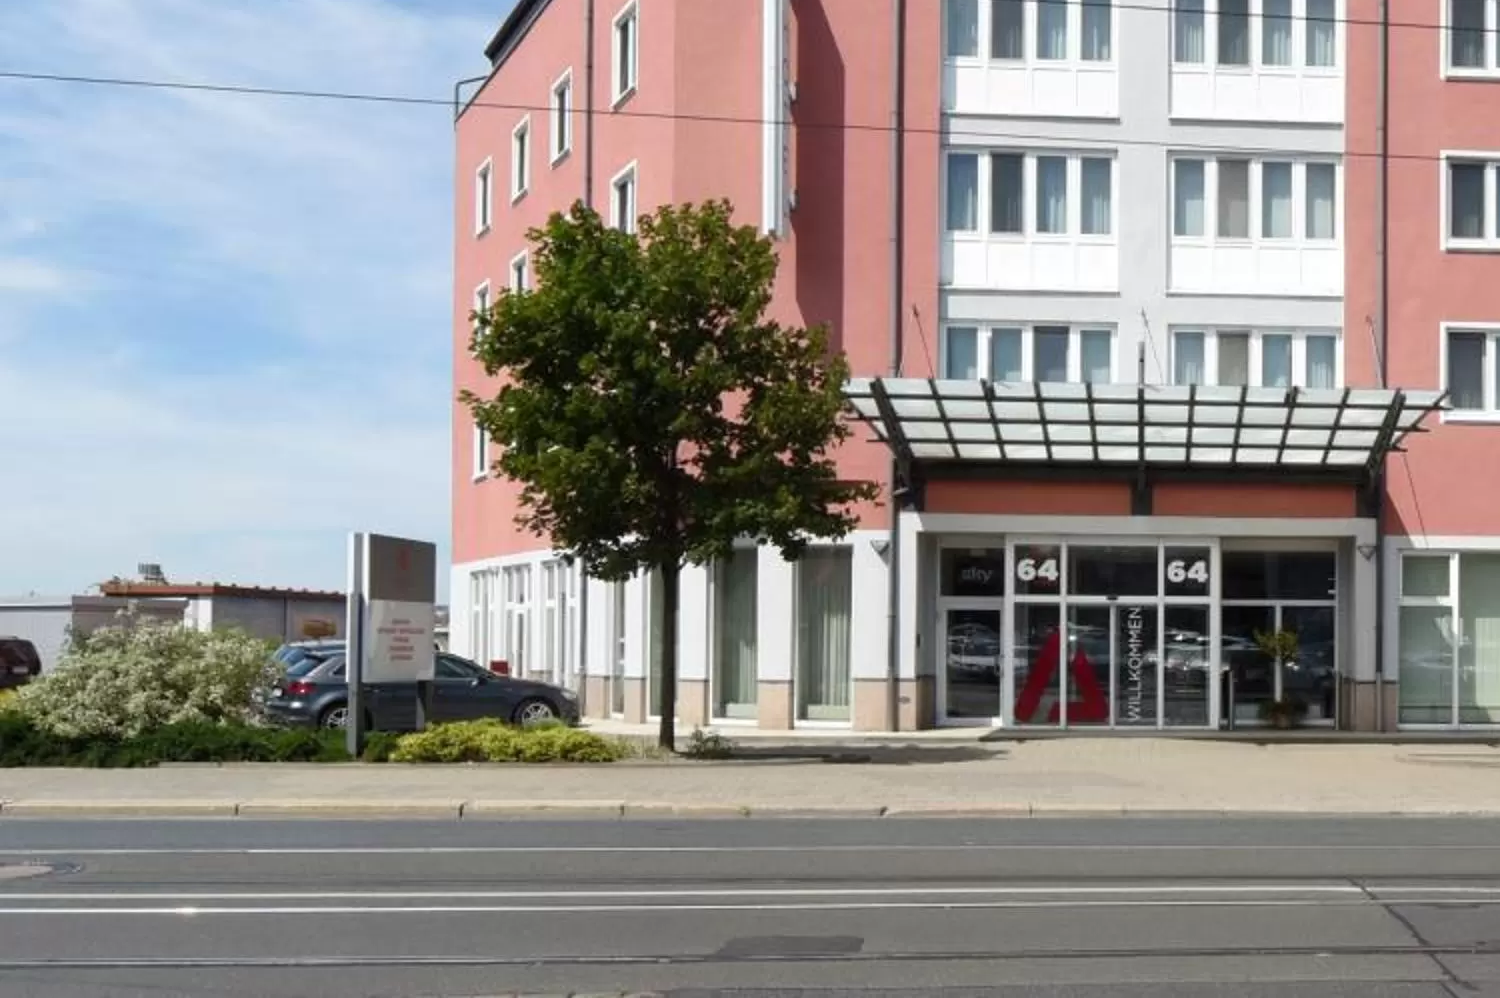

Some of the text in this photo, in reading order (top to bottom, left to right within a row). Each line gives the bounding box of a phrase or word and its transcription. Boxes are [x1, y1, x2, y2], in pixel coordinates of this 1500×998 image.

[1017, 558, 1059, 581] 64
[1167, 560, 1209, 583] 64
[1128, 606, 1142, 721] WILLKOMMEN
